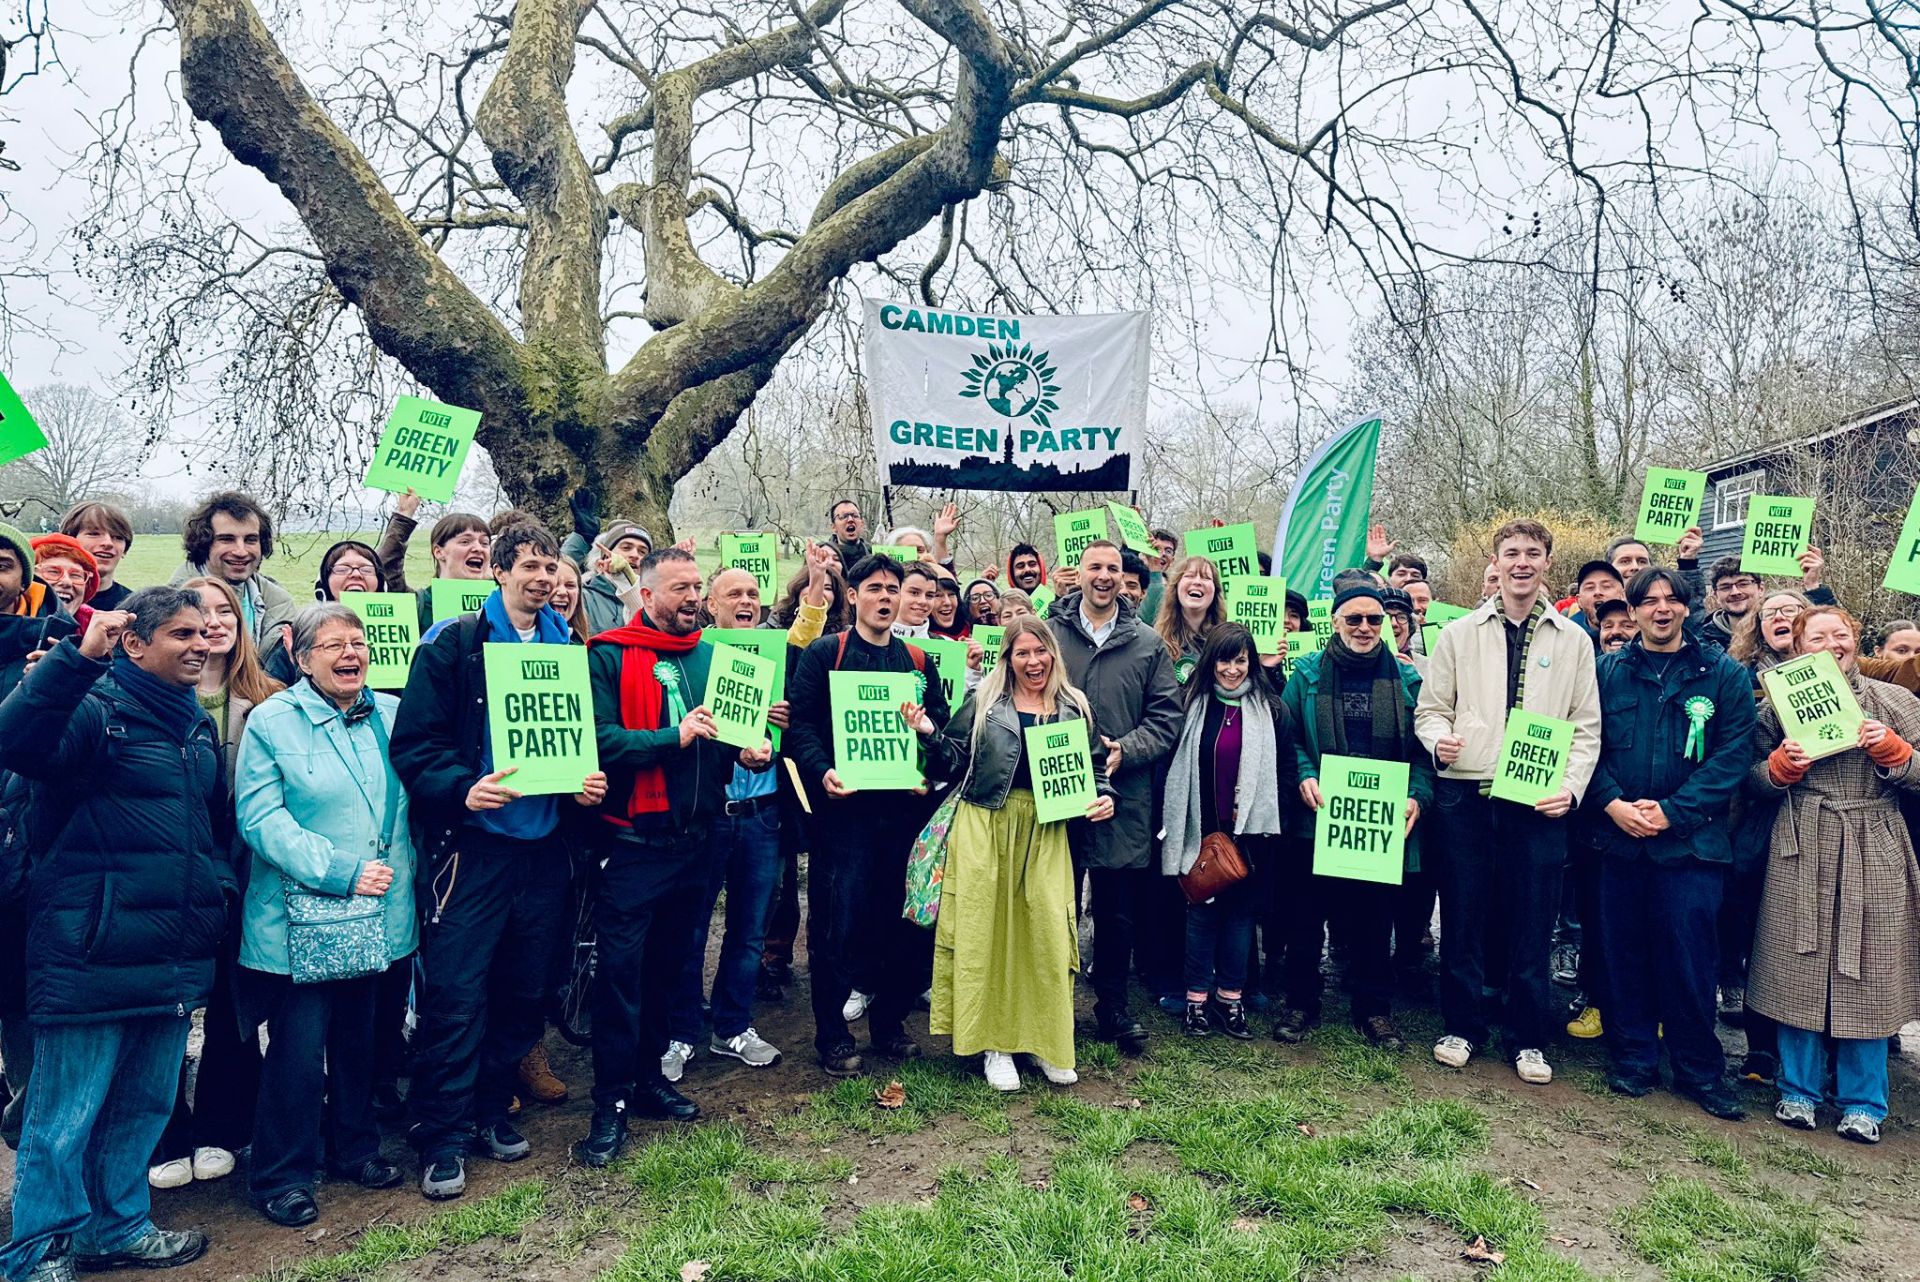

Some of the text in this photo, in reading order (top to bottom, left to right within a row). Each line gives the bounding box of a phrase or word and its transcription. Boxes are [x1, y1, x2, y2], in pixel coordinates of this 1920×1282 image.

[880, 305, 1020, 340] CAMDEN
[420, 410, 451, 428] VOTE
[394, 427, 459, 457] GREEN
[890, 420, 1122, 453] GREEN PARTY
[385, 448, 452, 478] PARTY
[1664, 478, 1686, 490] VOTE
[1322, 468, 1350, 531] Party
[1650, 492, 1694, 512] GREEN
[1646, 509, 1690, 529] PARTY
[1769, 506, 1792, 518] VOTE
[1071, 519, 1090, 531] VOTE
[1755, 522, 1801, 540] GREEN
[740, 543, 759, 553] VOTE
[1208, 537, 1233, 553] VOTE
[1752, 540, 1799, 558] PARTY
[1214, 556, 1250, 578] EEN
[1247, 585, 1268, 596] VOTE
[367, 604, 393, 617] VOTE
[1236, 601, 1278, 618] GREEN
[367, 624, 410, 643] REEN
[369, 647, 411, 666] ARTY
[523, 661, 559, 680] VOTE
[732, 660, 755, 679] VOTE
[1785, 665, 1817, 686] VOTE
[716, 676, 763, 707] GREEN
[859, 685, 889, 701] VOTE
[1787, 680, 1836, 709] GREEN
[505, 692, 582, 723] GREEN
[712, 697, 760, 728] PARTY
[1796, 696, 1842, 725] PARTY
[844, 710, 909, 734] GREEN
[1527, 723, 1552, 740] VOTE
[508, 728, 582, 759] PARTY
[846, 738, 910, 761] PARTY
[1046, 733, 1069, 749] VOTE
[1511, 740, 1559, 768] GREEN
[1039, 752, 1084, 777] GREEN
[1505, 760, 1554, 787] PARTY
[1042, 773, 1086, 799] PARTY
[1348, 771, 1380, 790] VOTE
[1330, 795, 1395, 826] GREEN
[1327, 824, 1393, 854] PARTY
